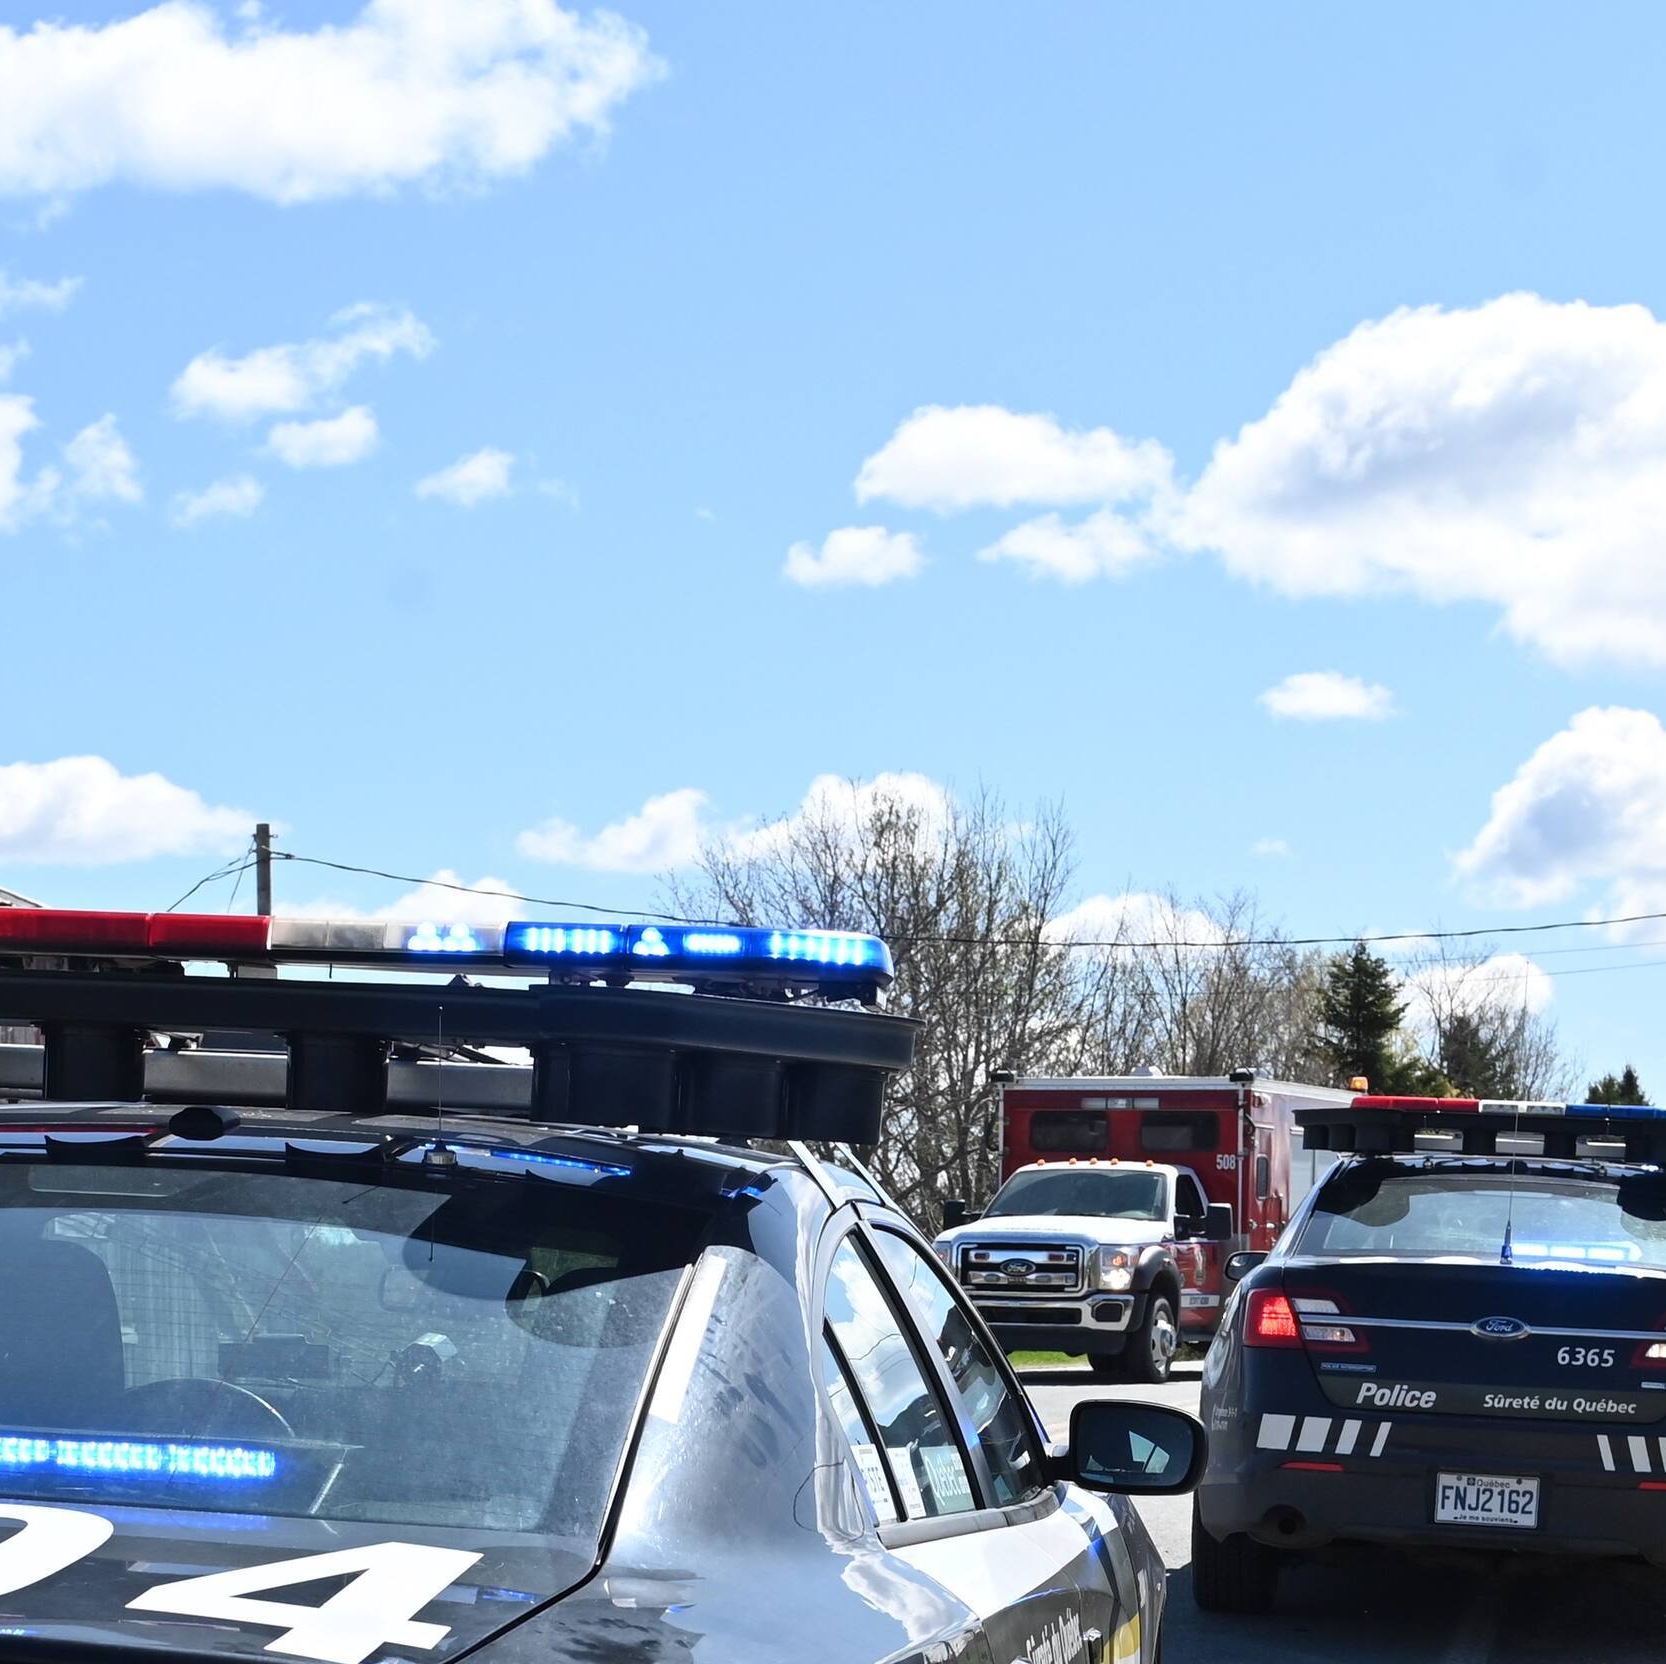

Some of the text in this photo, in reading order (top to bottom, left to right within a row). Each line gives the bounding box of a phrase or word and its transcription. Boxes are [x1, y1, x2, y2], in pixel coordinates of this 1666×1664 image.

[1216, 1153, 1237, 1170] 508
[1556, 1346, 1616, 1368] 6365
[1355, 1382, 1437, 1409] Police
[1483, 1394, 1637, 1415] Sûreté du Québec
[1476, 1478, 1510, 1489] Québec
[1440, 1485, 1534, 1515] FNJ2162
